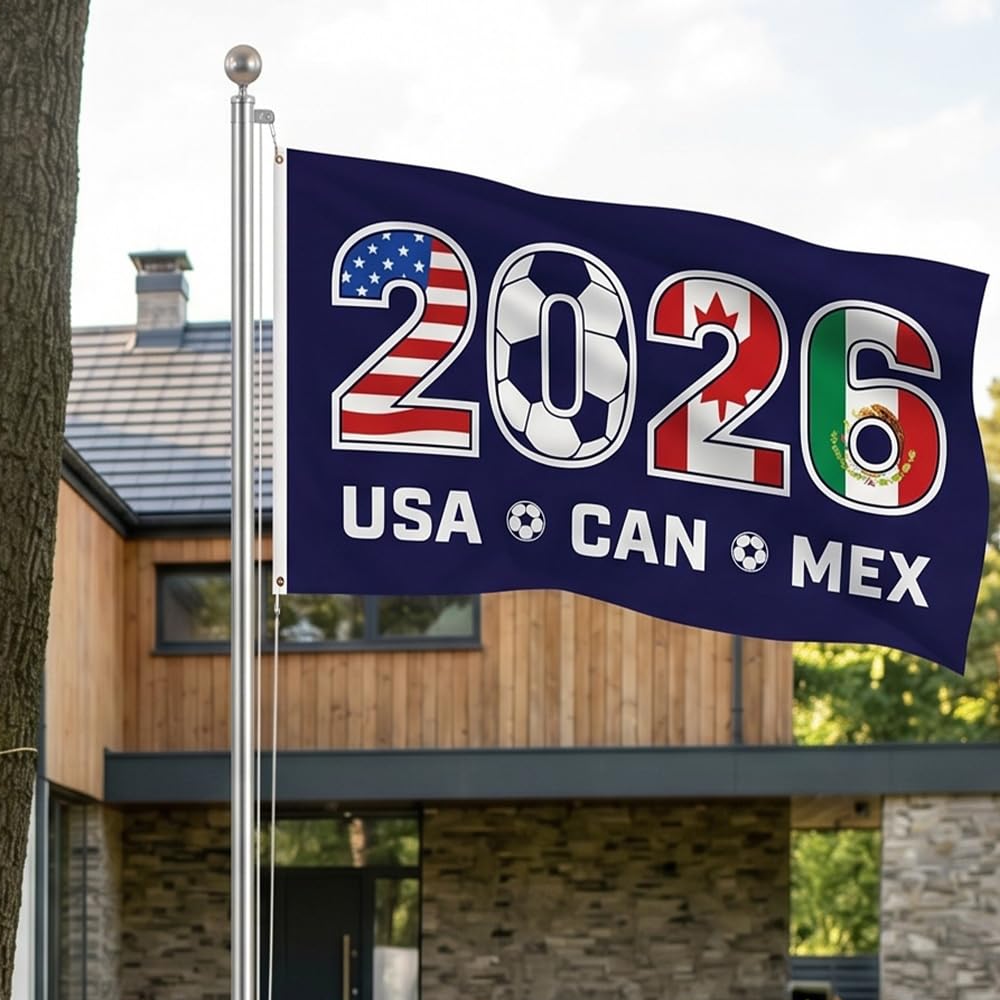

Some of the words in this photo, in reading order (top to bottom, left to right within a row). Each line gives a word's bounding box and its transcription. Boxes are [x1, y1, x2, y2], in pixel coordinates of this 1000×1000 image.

[331, 221, 948, 516] 2026
[342, 485, 482, 544] USA
[571, 503, 706, 571] CAN
[791, 535, 931, 607] MEX
